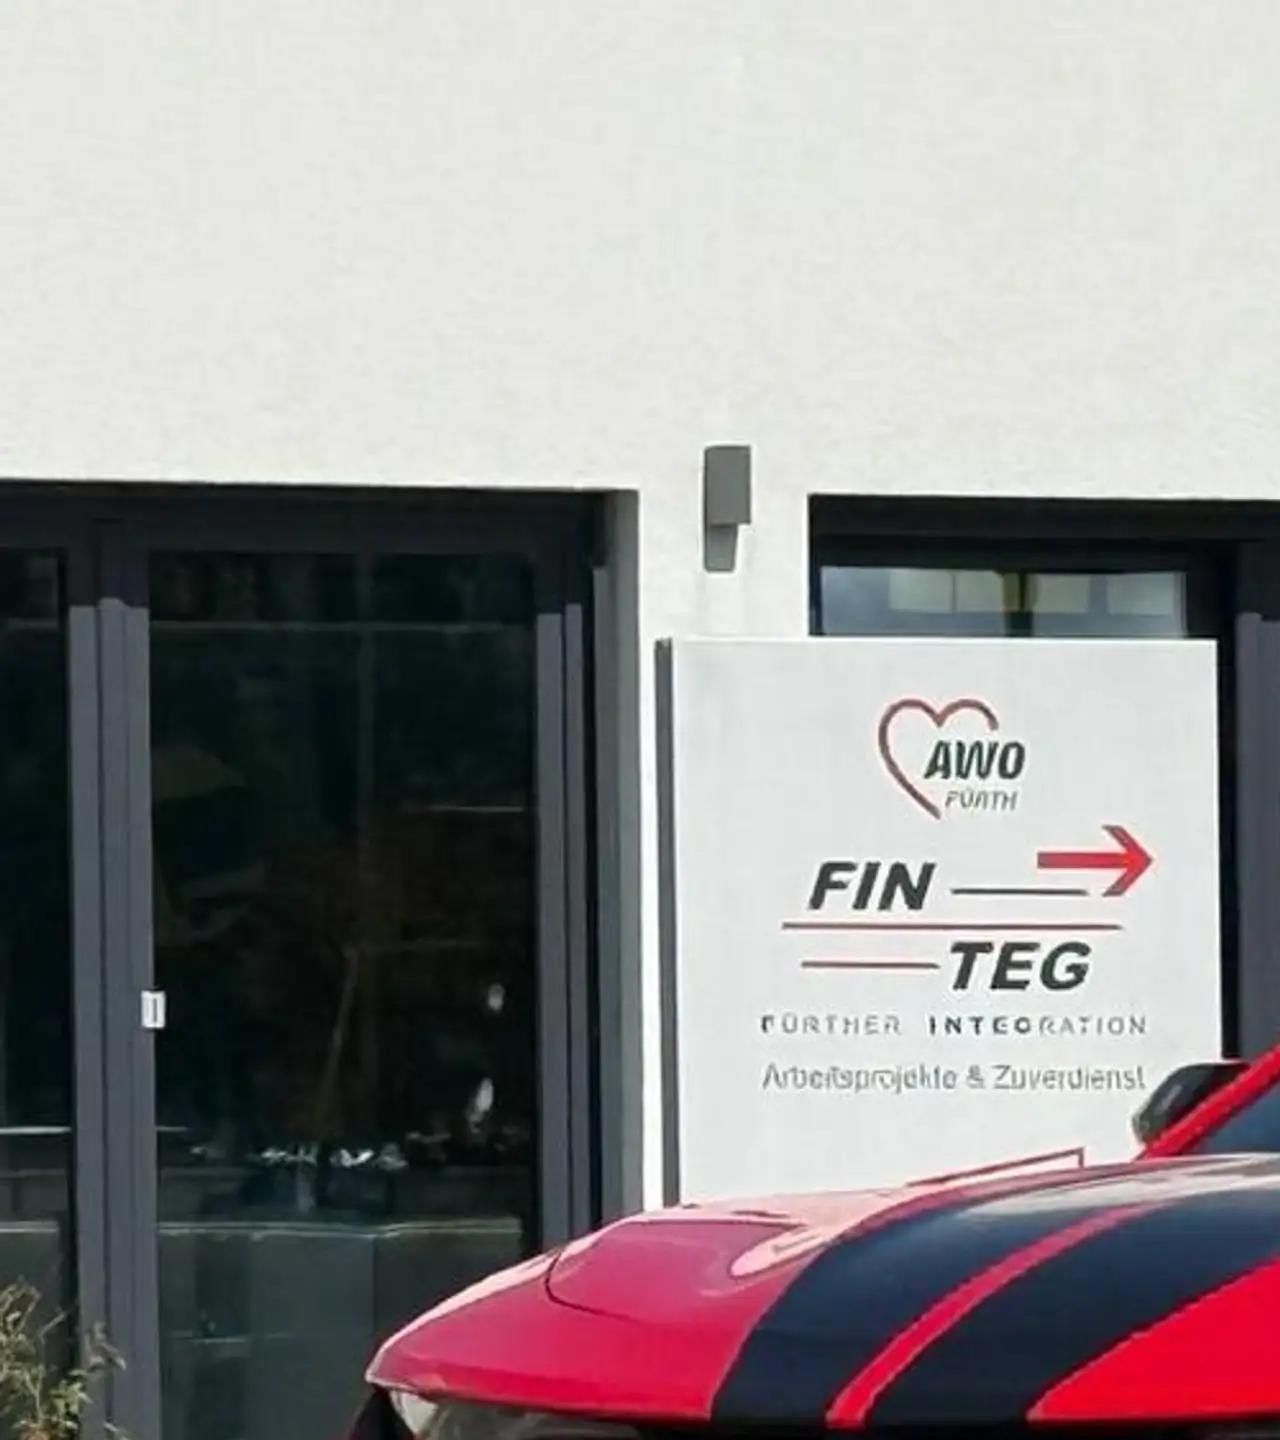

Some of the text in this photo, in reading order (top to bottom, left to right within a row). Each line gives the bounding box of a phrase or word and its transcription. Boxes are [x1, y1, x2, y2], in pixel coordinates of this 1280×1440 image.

[923, 740, 1025, 780] AWO
[945, 788, 1018, 811] FÜRTH
[807, 861, 937, 912] FIN
[950, 941, 1092, 991] TEG
[761, 1013, 1146, 1037] FÜRTHER INTEGRATION
[763, 1063, 1147, 1095] Arbeitsprojekte & Zuverdienst
